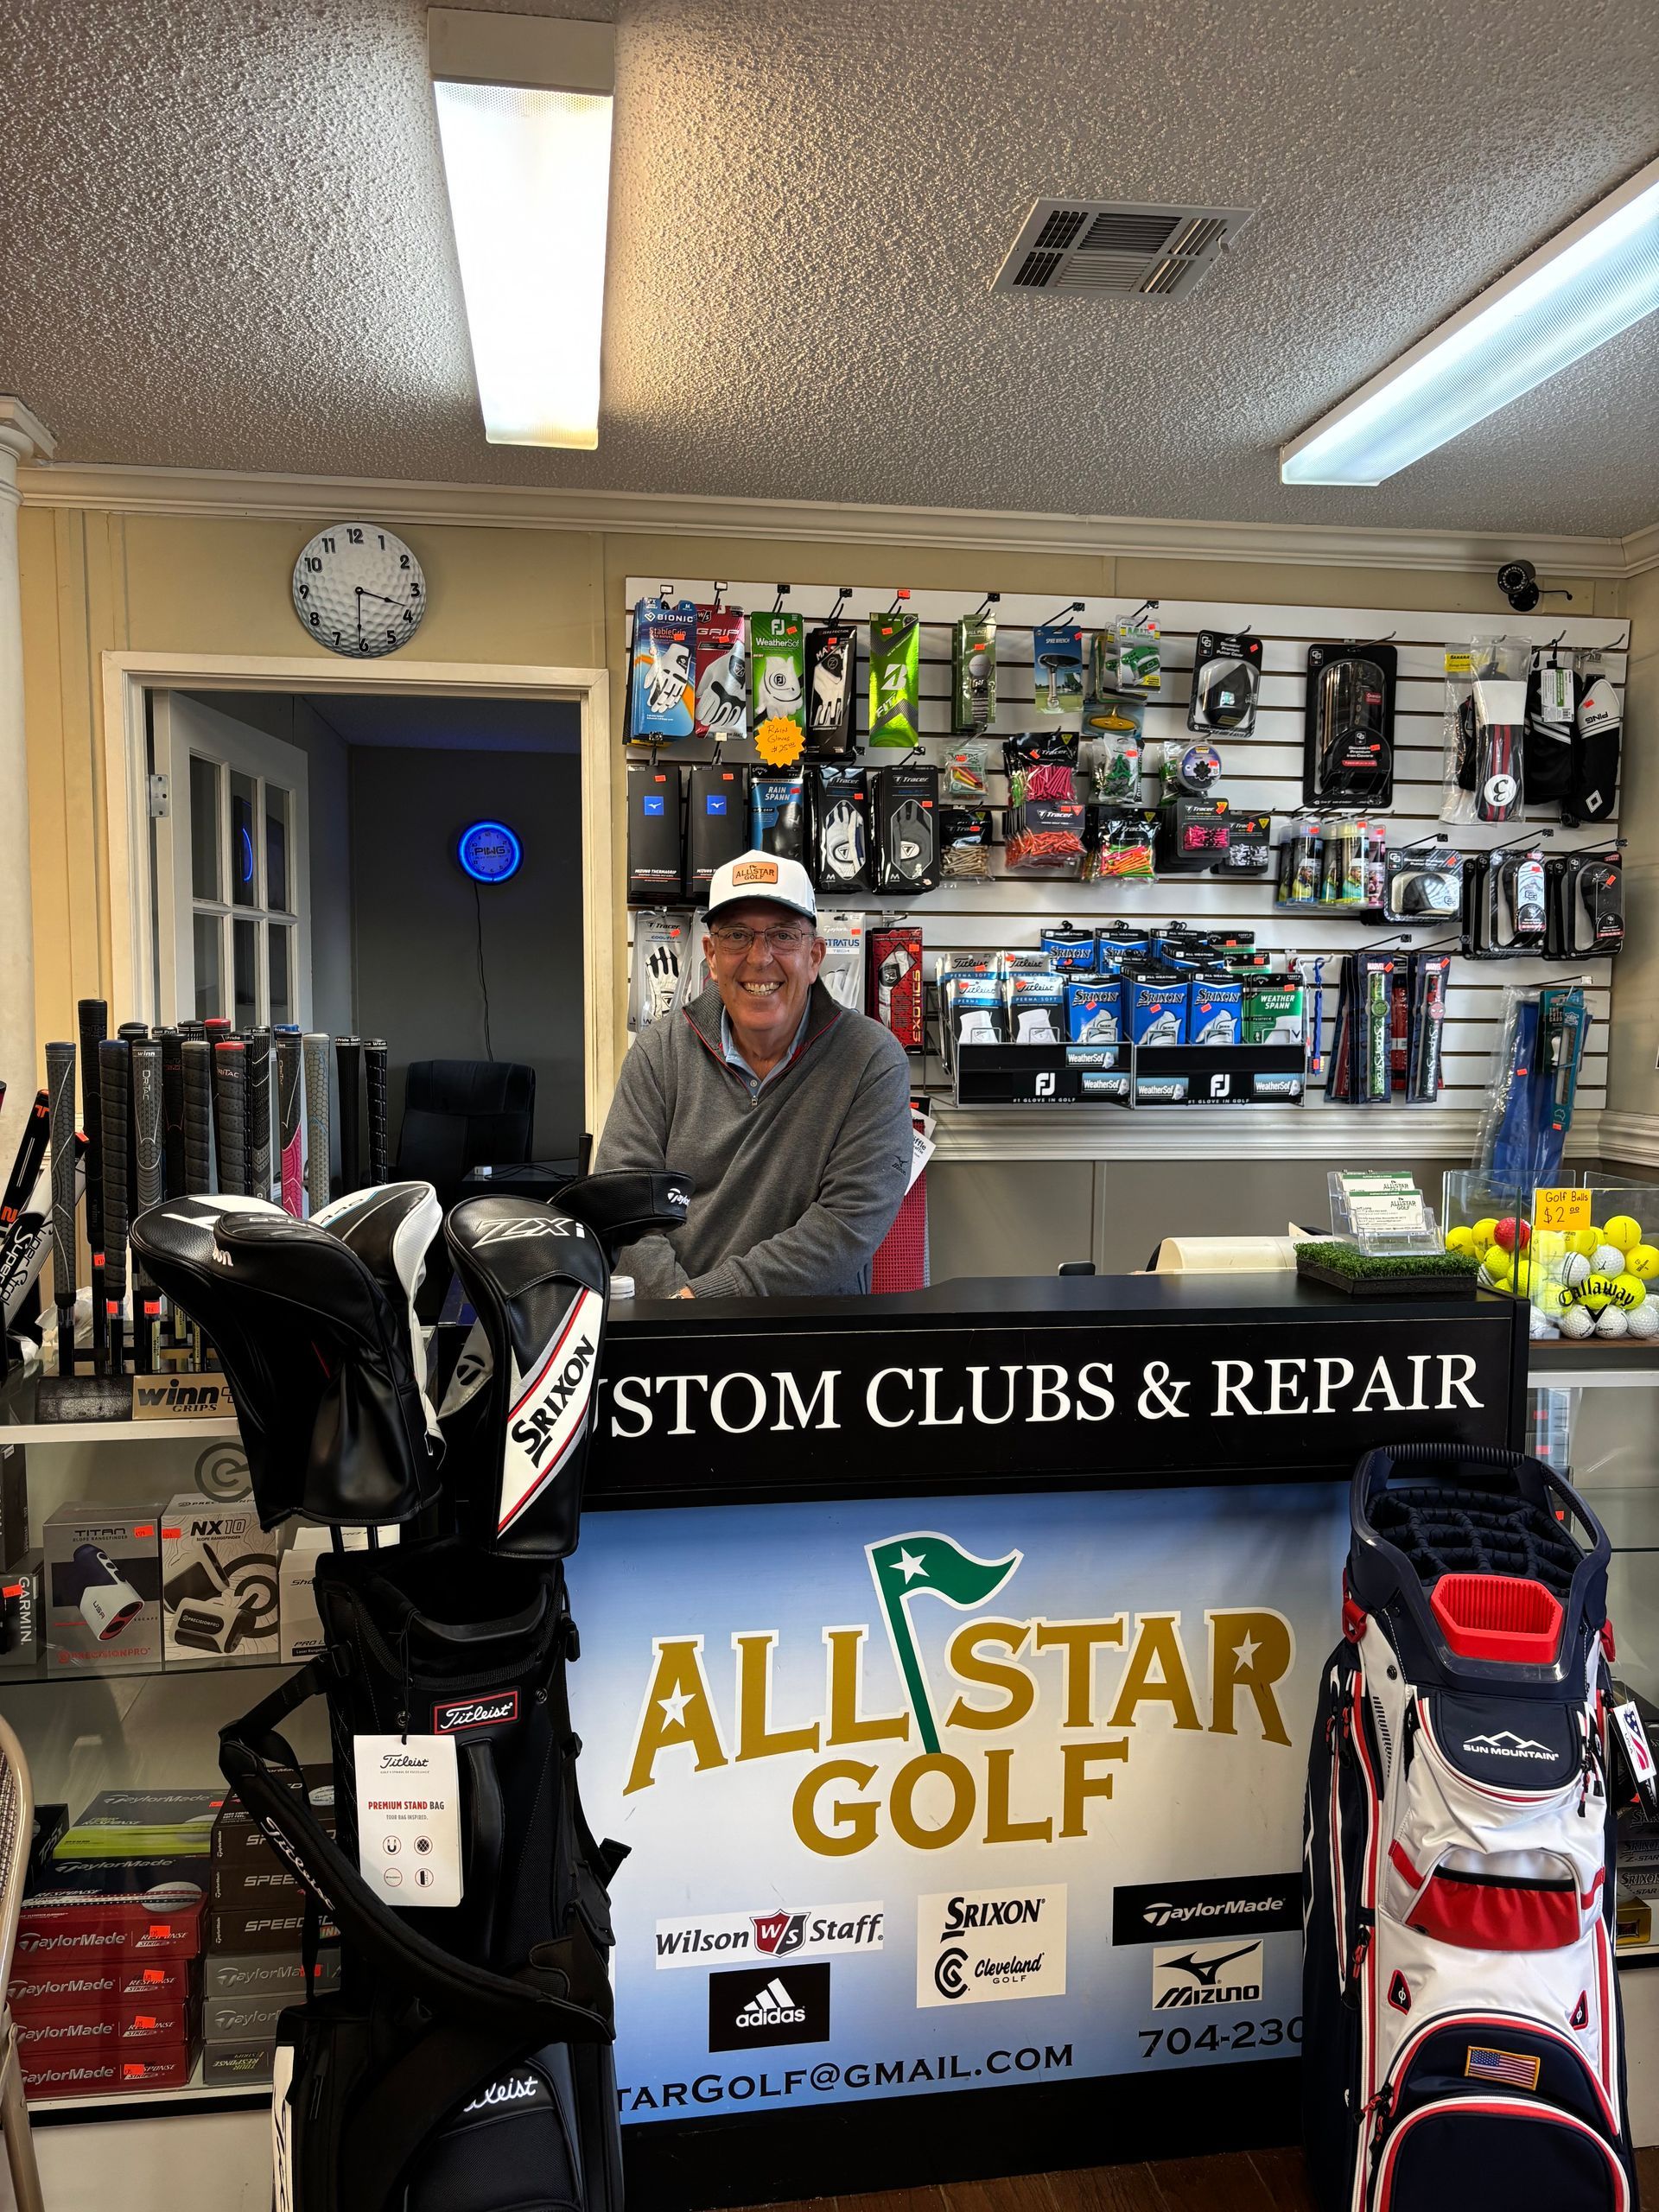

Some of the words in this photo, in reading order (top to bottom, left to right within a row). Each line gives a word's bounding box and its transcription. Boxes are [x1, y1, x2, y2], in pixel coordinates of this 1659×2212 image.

[346, 529, 364, 543] 12
[378, 535, 385, 550] 1
[321, 537, 336, 553] 11
[305, 557, 322, 573] 10
[399, 555, 410, 569] 2
[299, 585, 309, 600] 9
[410, 583, 420, 597] 3
[309, 612, 321, 626] 8
[403, 609, 413, 623] 4
[772, 620, 785, 635] FJ
[332, 632, 341, 645] 7
[387, 630, 397, 644] 5
[359, 638, 369, 652] 6
[1585, 711, 1609, 724] PING
[474, 846, 505, 855] PING
[1050, 946, 1091, 959] SRIXON
[952, 957, 989, 969] Titleist
[1009, 958, 1044, 969] Titleist
[959, 982, 996, 994] Titleist
[1017, 982, 1055, 993] Titleist
[1072, 989, 1119, 1006] SRIXON
[1136, 990, 1185, 1007] SRIXON
[1194, 988, 1242, 1005] SRIXON
[912, 969, 921, 1042] EXOTICS
[1068, 1053, 1104, 1064] WeatherSof
[217, 1067, 239, 1077] RITAC
[1035, 1072, 1056, 1096] FJ
[1084, 1079, 1119, 1089] WeatherSof
[1138, 1084, 1173, 1095] WeatherSof
[1210, 1074, 1230, 1096] FJ
[1255, 1081, 1291, 1091] WeatherSof
[1545, 1191, 1567, 1203] Golf
[1571, 1191, 1588, 1203] Balls
[1558, 1279, 1635, 1306] Callaway
[138, 1378, 219, 1407] winn
[593, 1370, 842, 1439] STOM
[866, 1362, 1115, 1427] CLUBS
[1136, 1360, 1191, 1420] &
[1211, 1353, 1485, 1417] REPAIR
[173, 1403, 218, 1413] GRIPS
[511, 1334, 594, 1468] SRIXON
[190, 1518, 247, 1536] NX10
[18, 1576, 32, 1643] GARMIN
[92, 1600, 105, 1619] USA
[622, 1626, 912, 1797] ALL
[944, 1609, 1295, 1749] STAR
[441, 1701, 513, 1729] Titleist
[1463, 1744, 1489, 1755] SUN
[1490, 1746, 1559, 1761] MOUNTAIN
[380, 1754, 429, 1769] Titleist
[104, 1795, 210, 1805] TaylorMade
[791, 1735, 1131, 1858] GOLF
[368, 1801, 403, 1810] PREMIUM
[404, 1801, 428, 1809] STAND
[429, 1801, 445, 1809] BAG
[55, 1859, 175, 1873] TaylorMade
[1142, 1897, 1285, 1927] TaylorMade
[939, 1896, 1045, 1944] SRIXON
[656, 1929, 749, 1955] Wilson
[809, 1913, 883, 1944] Staff
[19, 1932, 126, 1953] TaylorMade
[974, 1953, 1045, 1979] Cleveland
[992, 1974, 1028, 1984] GOLF
[7, 1978, 114, 1999] TaylorMade
[735, 2006, 805, 2028] adidas
